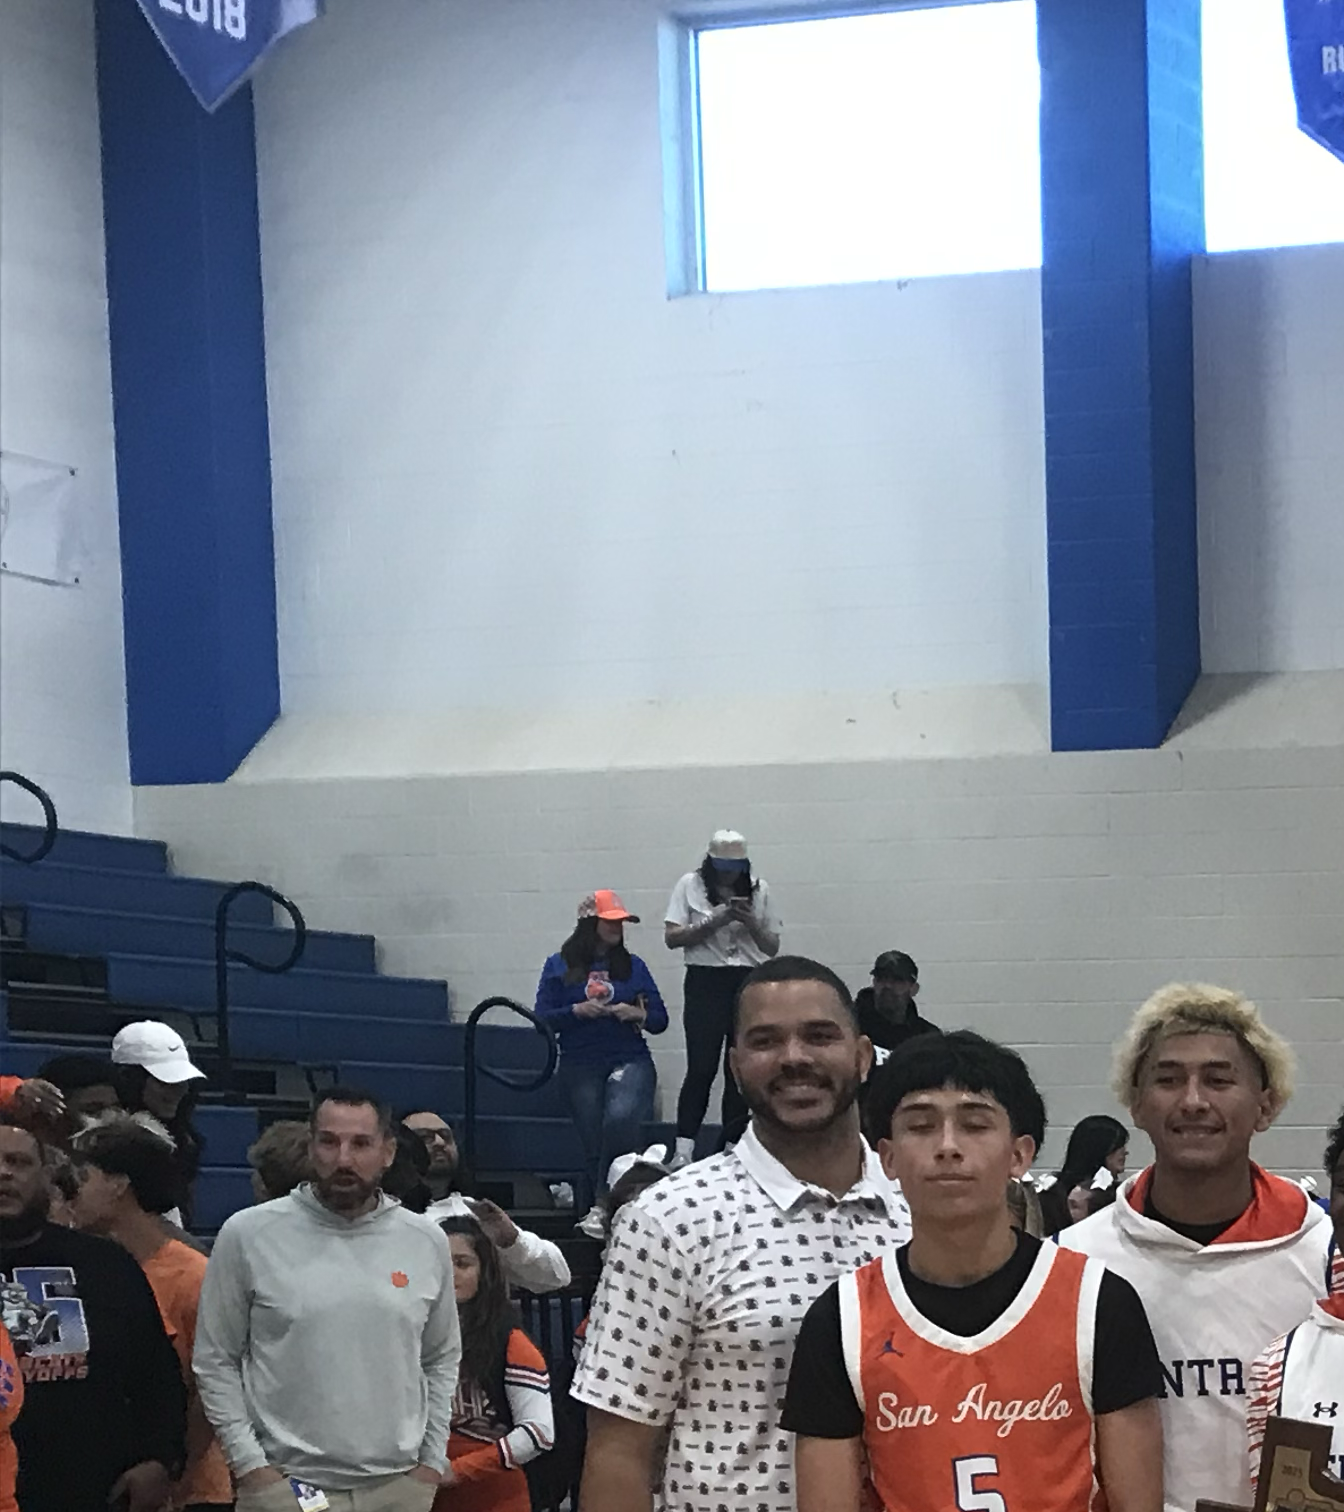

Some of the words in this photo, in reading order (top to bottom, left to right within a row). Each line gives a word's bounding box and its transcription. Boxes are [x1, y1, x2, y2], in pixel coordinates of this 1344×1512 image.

[158, 0, 247, 41] 018
[876, 1392, 939, 1432] San
[952, 1383, 1073, 1438] Angelo
